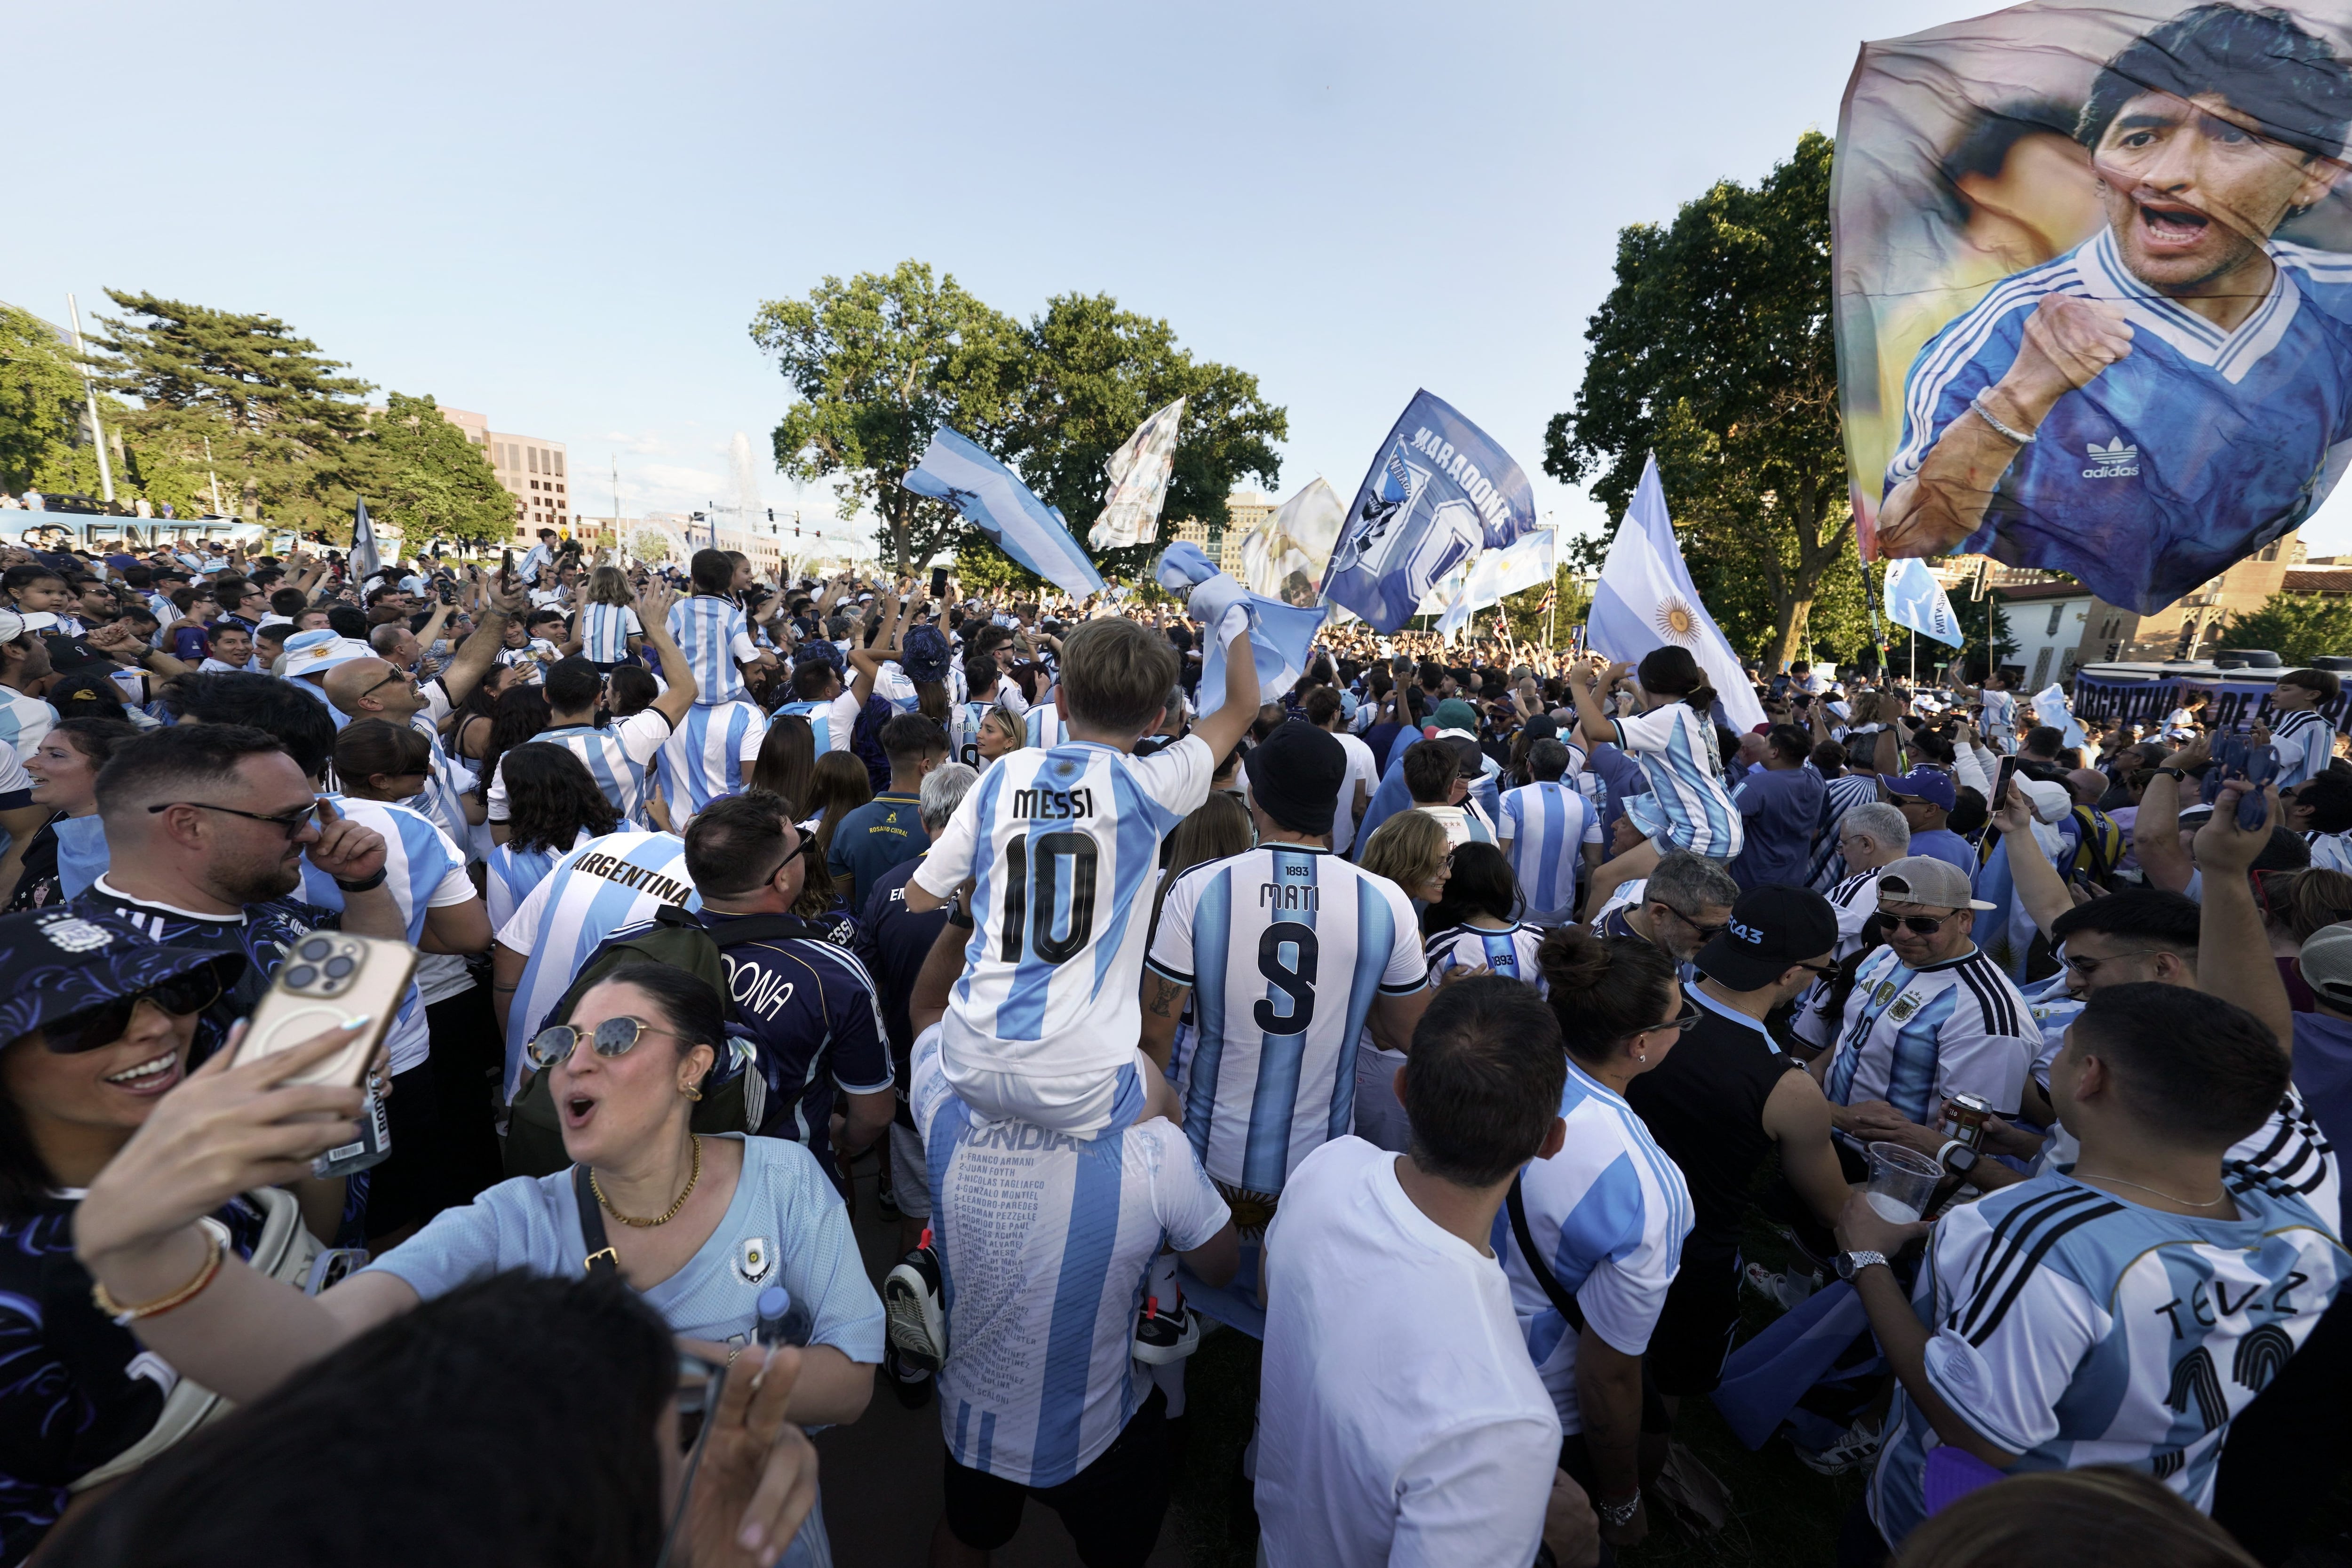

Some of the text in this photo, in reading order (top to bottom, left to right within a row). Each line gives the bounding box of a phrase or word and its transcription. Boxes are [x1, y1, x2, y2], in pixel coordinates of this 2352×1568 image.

[2082, 463, 2137, 479] adidas
[1410, 426, 1511, 533] MARADONA
[1013, 788, 1093, 820] MESSI
[1285, 866, 1309, 876] 1893
[571, 852, 693, 908] ARGENTINA
[1001, 832, 1098, 964] 10
[1259, 883, 1320, 912] MATI
[1491, 954, 1514, 967] 1893
[1253, 921, 1319, 1036] 9
[1000, 1157, 1034, 1167] ARMANI
[989, 1167, 1015, 1177] FOYTH
[1001, 1190, 1039, 1201] MONTIEL
[996, 1211, 1037, 1222] PEZZELLE
[1009, 1222, 1030, 1231] PAUL
[989, 1241, 1023, 1250] ALVAREZ
